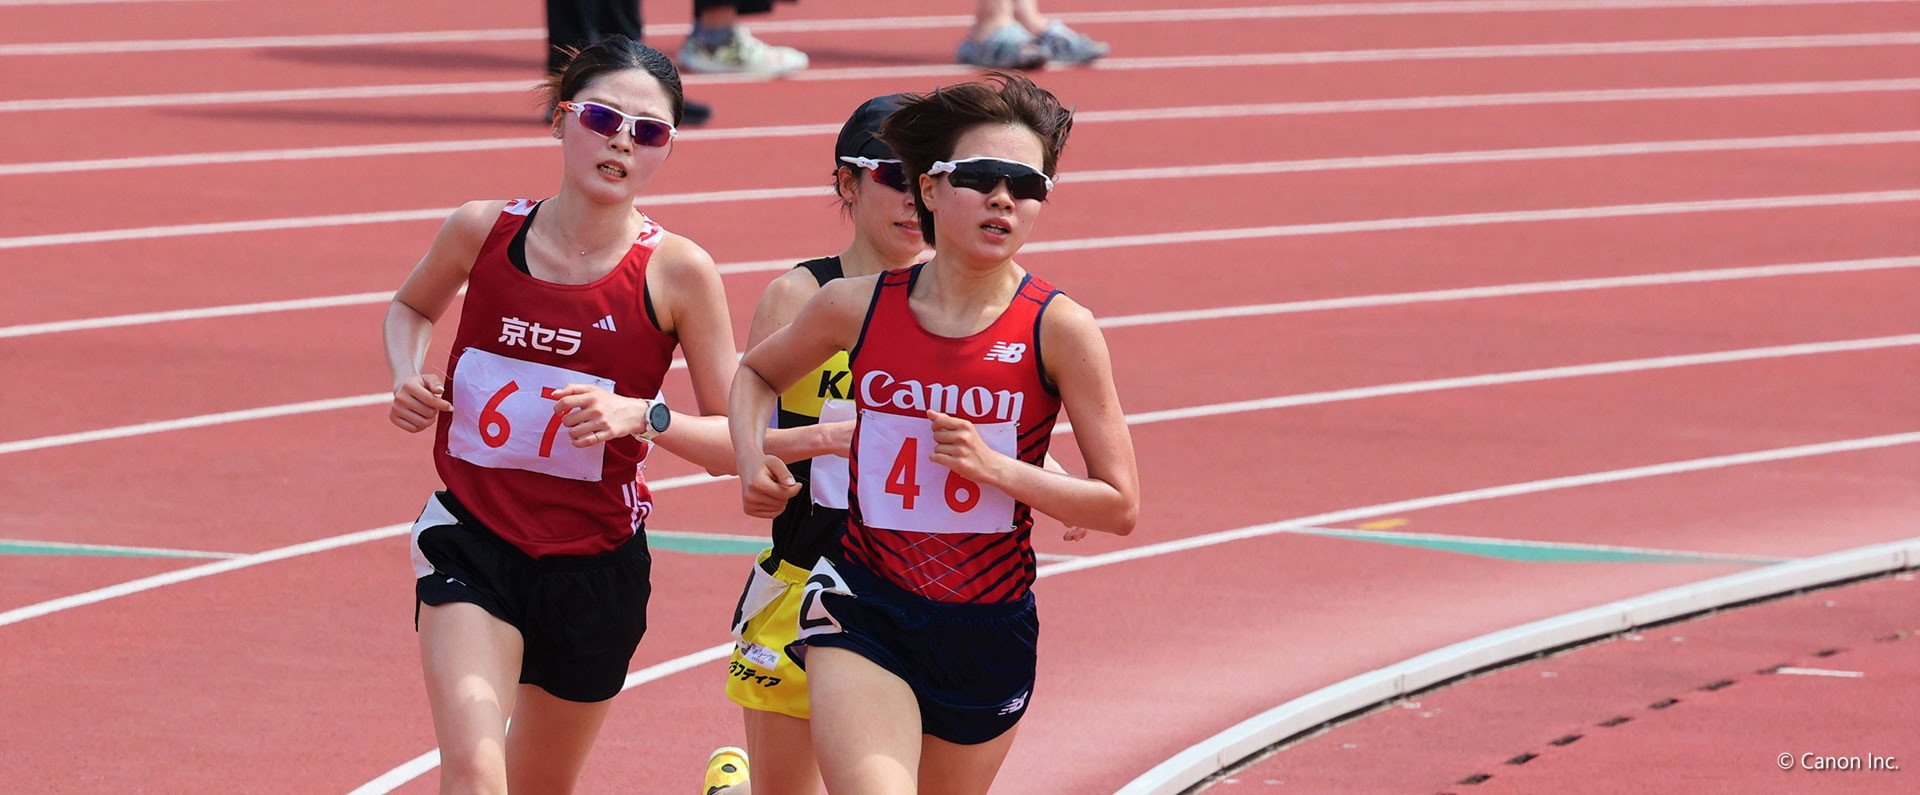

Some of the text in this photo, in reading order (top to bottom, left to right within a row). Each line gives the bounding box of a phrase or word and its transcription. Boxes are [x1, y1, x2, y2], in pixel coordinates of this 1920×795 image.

[498, 317, 582, 356] 京セラ
[478, 380, 573, 458] 67
[860, 370, 1024, 421] Canon
[885, 437, 981, 513] 46
